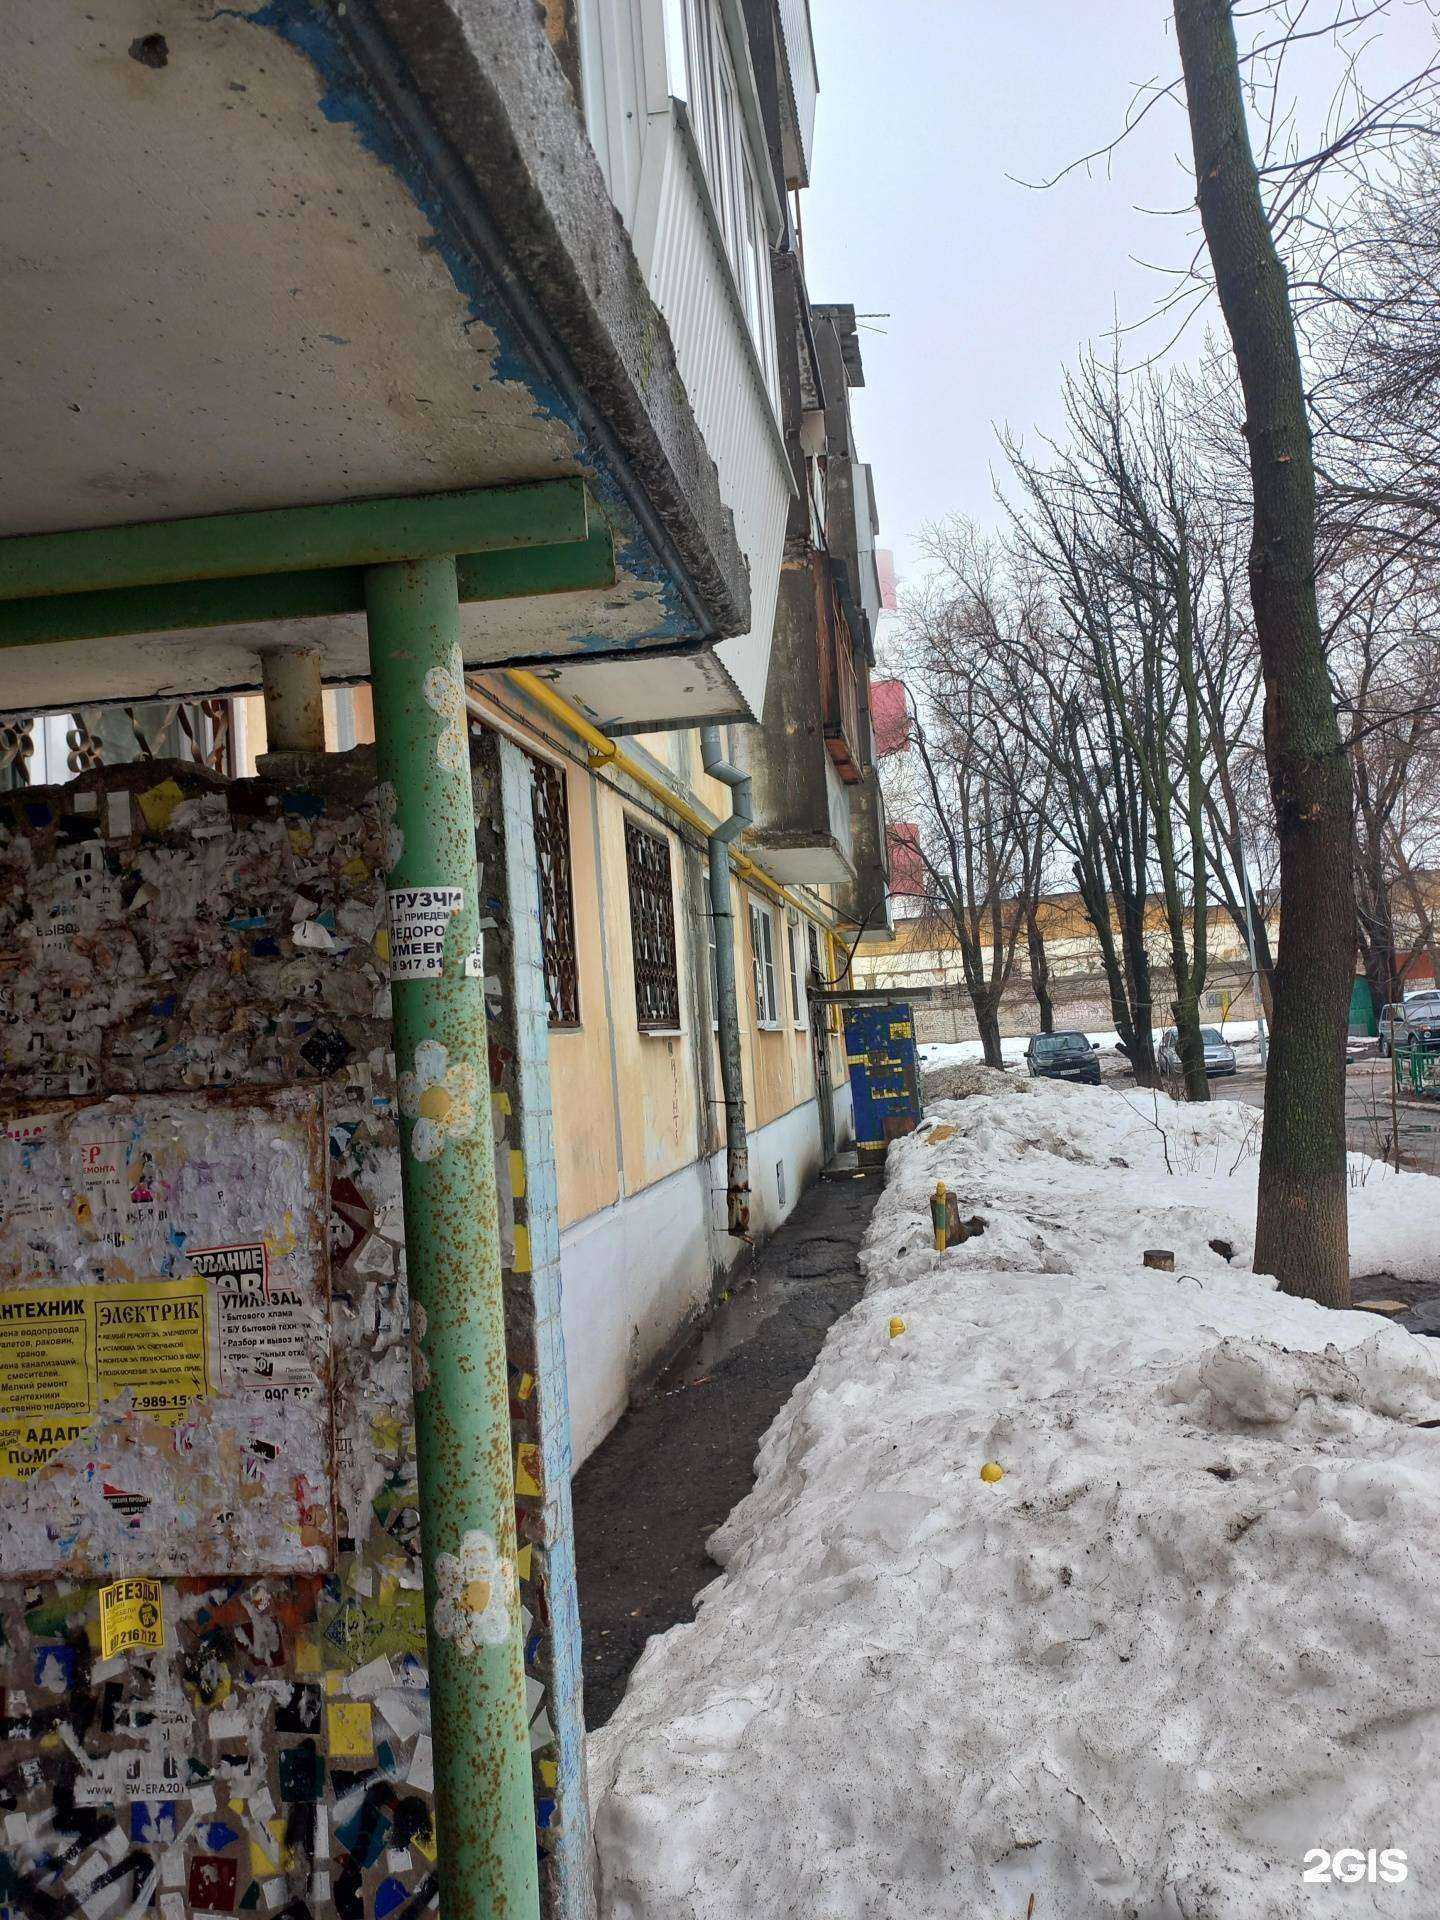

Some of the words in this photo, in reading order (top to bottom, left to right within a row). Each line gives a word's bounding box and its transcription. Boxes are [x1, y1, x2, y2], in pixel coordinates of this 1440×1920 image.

[212, 1273, 264, 1300] ОВ
[222, 1292, 302, 1310] УТИЛЗАЦ
[0, 1299, 84, 1319] НТЕХНИК
[100, 1302, 200, 1326] ЭЛЕКТРИК
[226, 1312, 265, 1321] Бытового
[20, 1325, 79, 1337] водопровода
[241, 1322, 276, 1332] бытовой
[227, 1339, 257, 1347] Разбор
[266, 1337, 292, 1345] вывоз
[1, 1381, 35, 1391] Мелкий
[37, 1380, 68, 1389] ремонт
[131, 1395, 191, 1408] 7-989-15
[27, 1425, 87, 1445] АДАП
